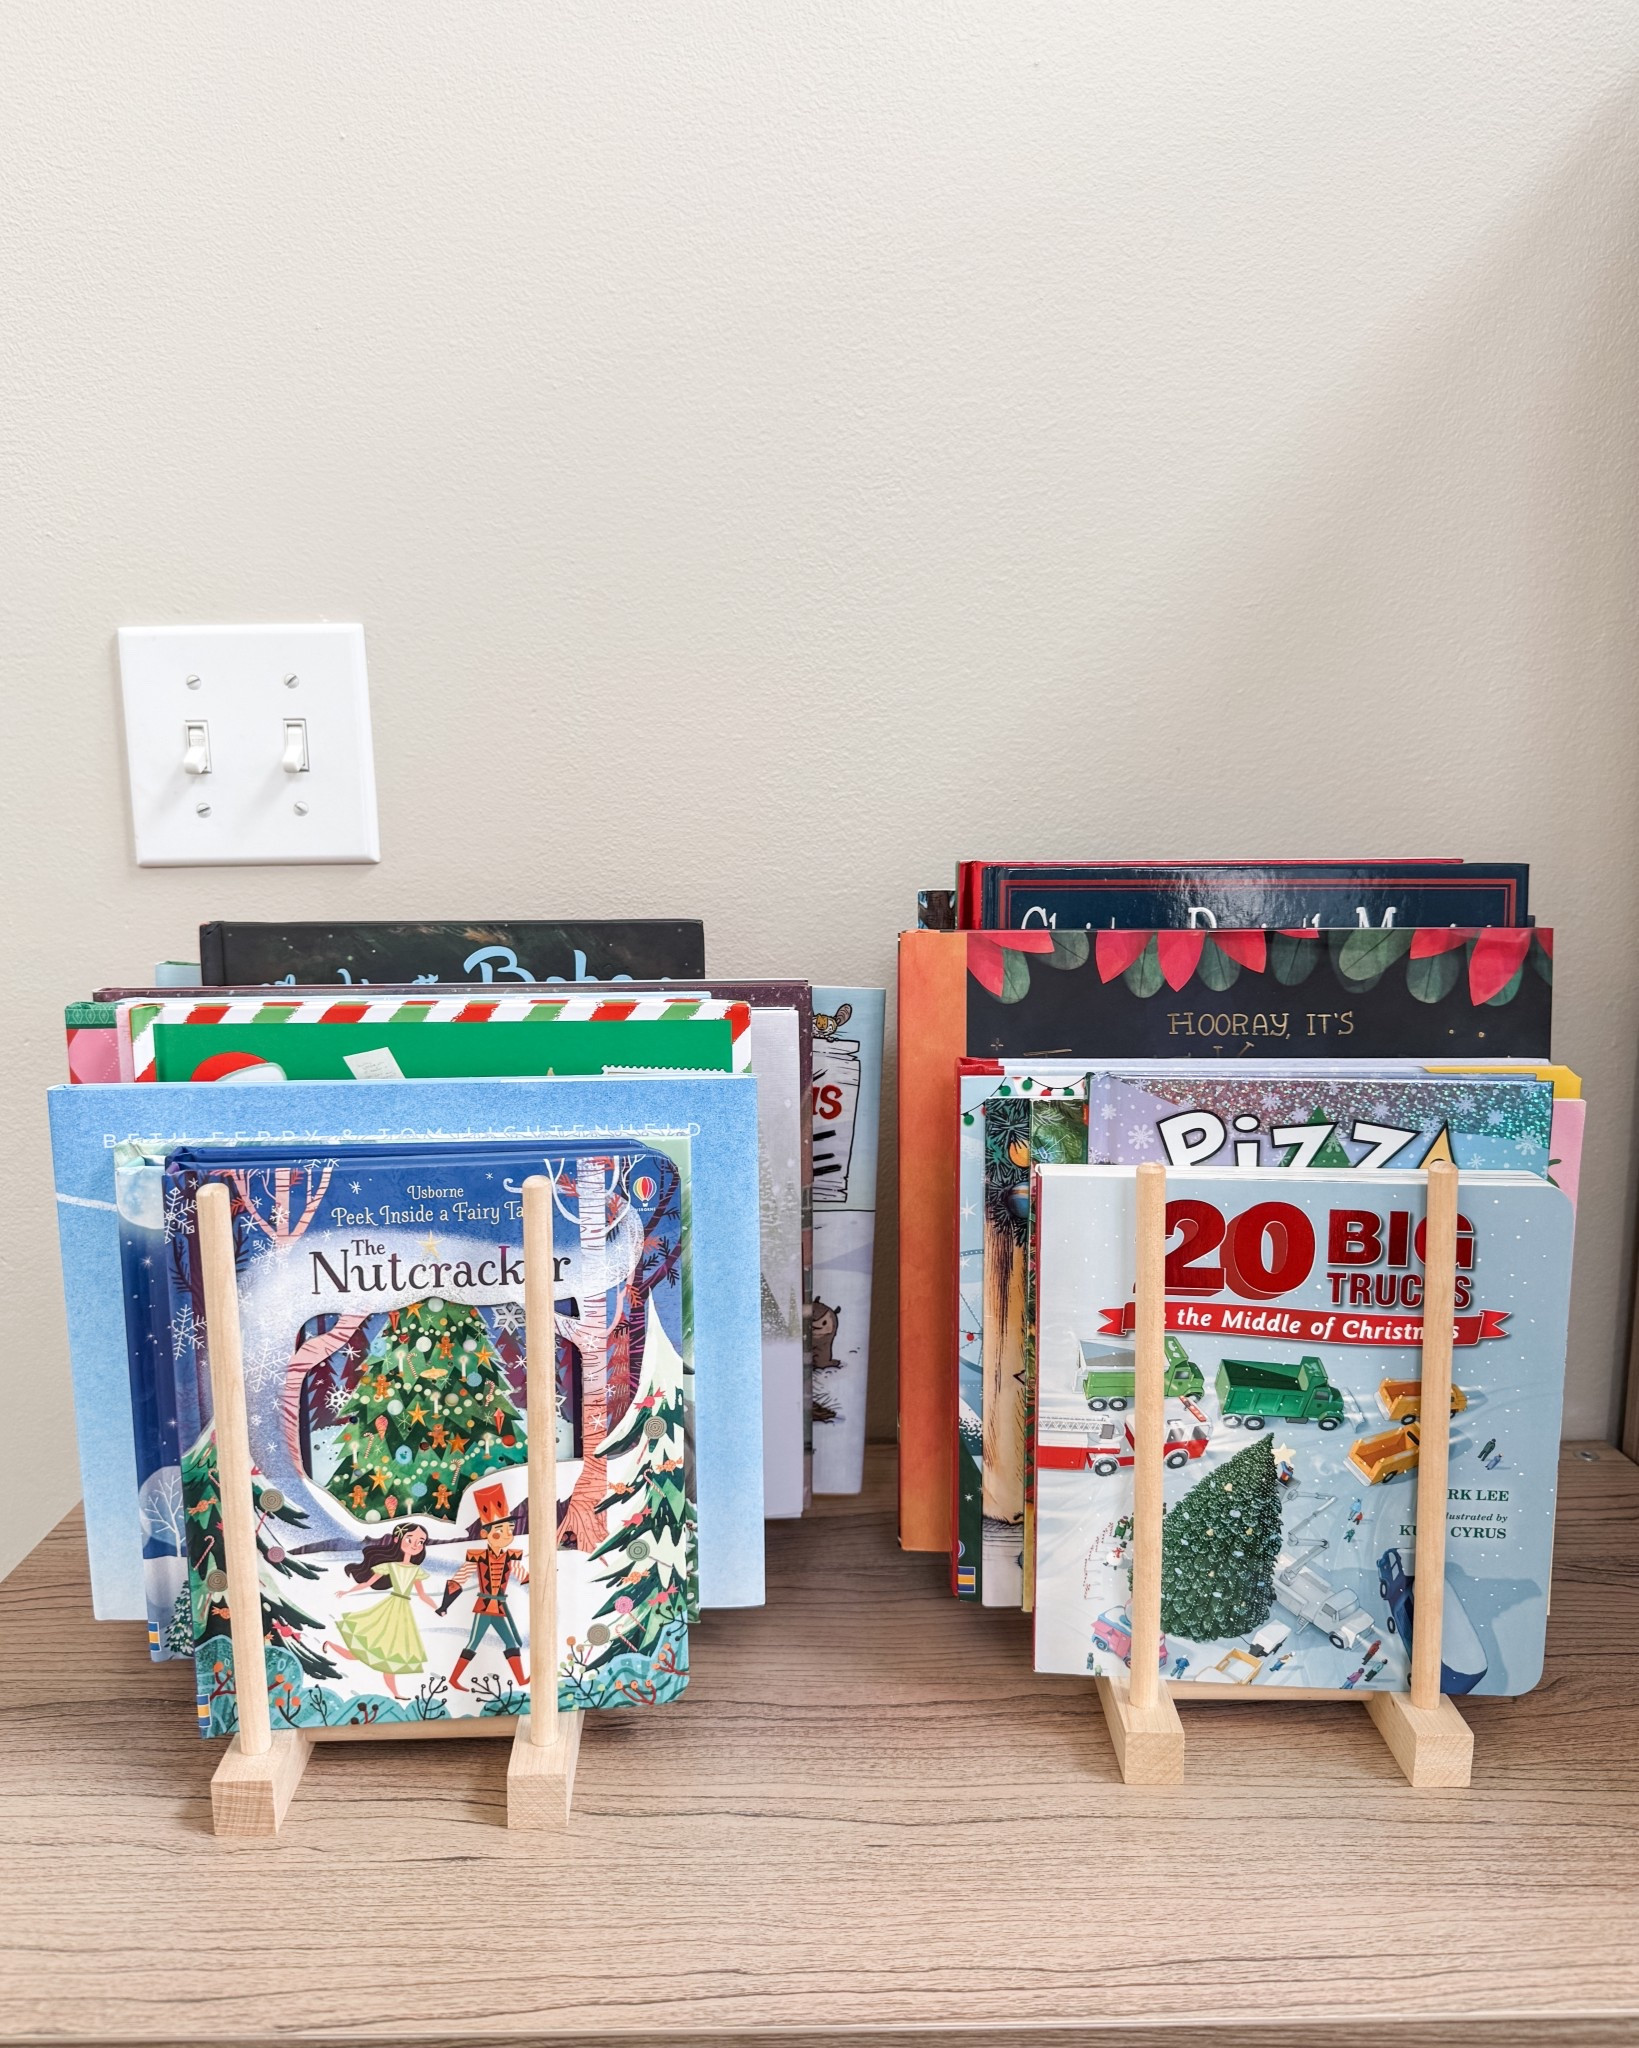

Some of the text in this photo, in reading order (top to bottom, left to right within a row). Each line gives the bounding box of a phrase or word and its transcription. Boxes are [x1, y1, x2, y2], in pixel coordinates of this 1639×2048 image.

[1167, 1011, 1354, 1040] HOORAY, IT'S
[407, 1185, 464, 1200] Usborne
[331, 1200, 524, 1227] Peek Inside a Fairy Ta
[351, 1238, 386, 1256] The
[1134, 1199, 1317, 1301] 20
[309, 1245, 571, 1295] Nutcrackr
[1326, 1272, 1472, 1309] TRUCS
[1177, 1306, 1213, 1327] the
[1221, 1309, 1300, 1335] Middle
[1310, 1315, 1336, 1341] of
[1342, 1322, 1460, 1341] Christms
[1447, 1488, 1510, 1502] RK LEE
[1446, 1511, 1508, 1523] lustrated by
[1450, 1526, 1507, 1540] CYRUS
